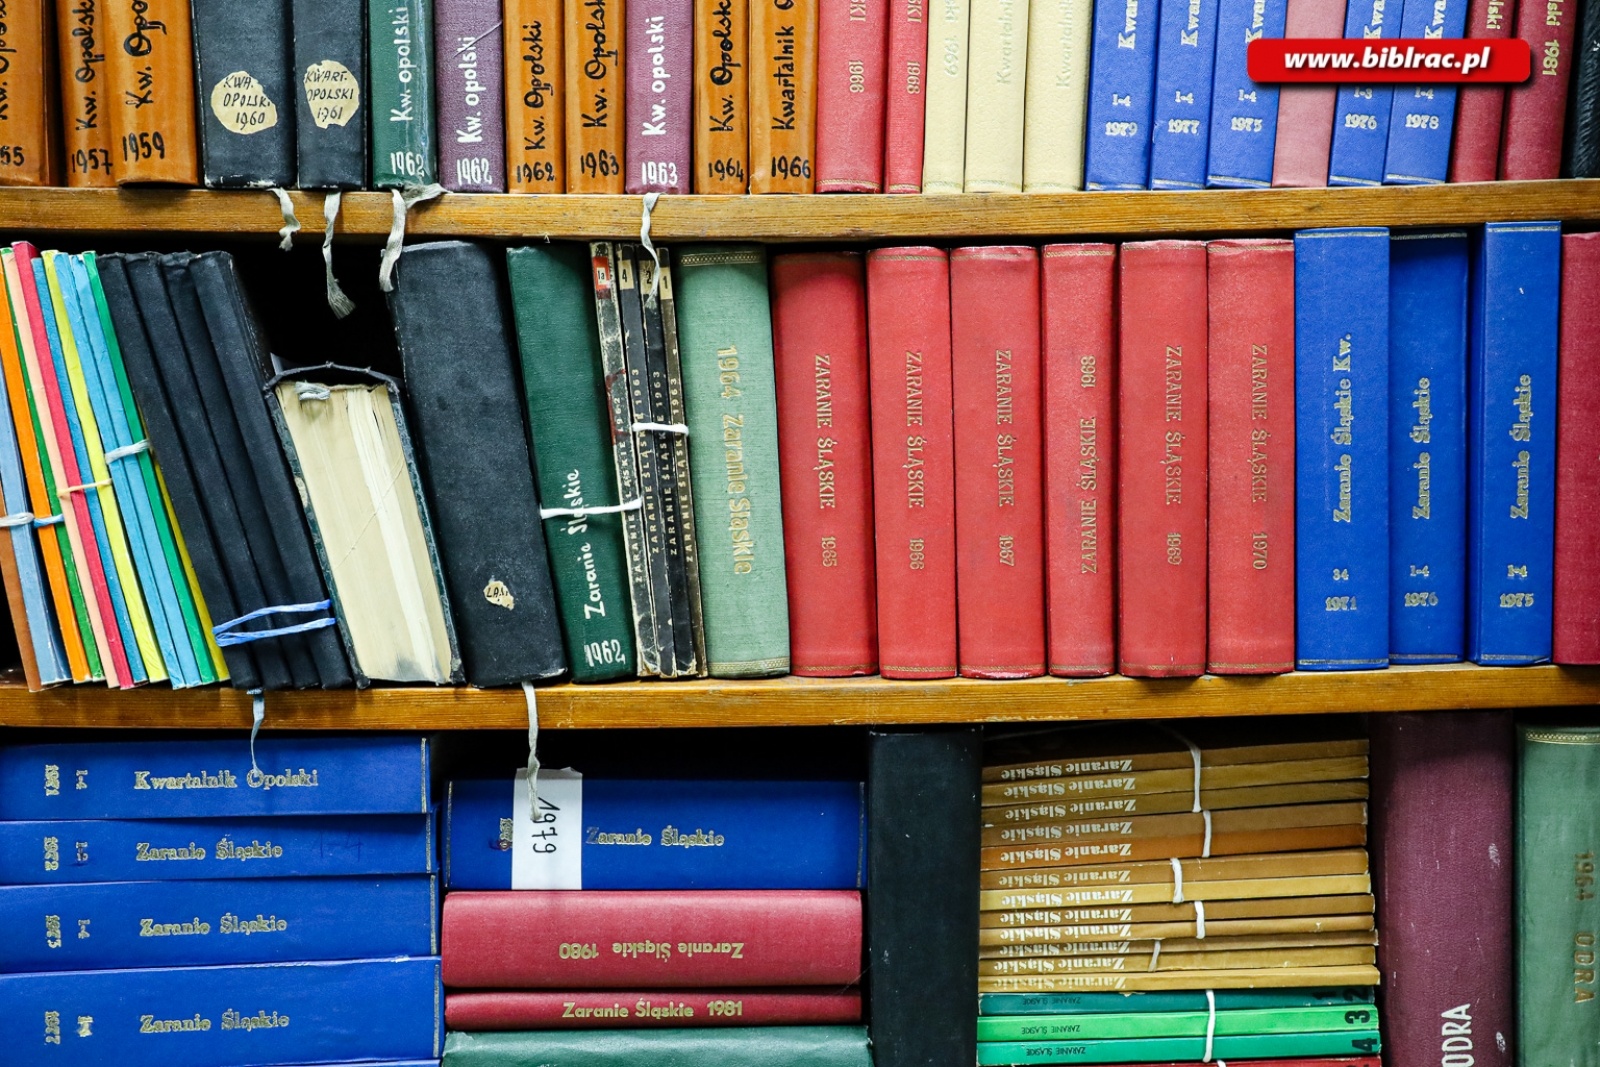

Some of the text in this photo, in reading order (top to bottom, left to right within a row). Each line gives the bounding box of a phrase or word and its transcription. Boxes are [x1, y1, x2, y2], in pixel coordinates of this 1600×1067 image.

[1542, 39, 1560, 76] 1981
[126, 67, 154, 108] Kw.
[456, 35, 486, 144] Kw. opolski
[642, 15, 672, 136] Kw. opolski
[771, 25, 796, 131] Kwartalnik
[848, 60, 865, 94] 1966
[906, 60, 921, 95] 1968
[75, 91, 97, 131] Kw.
[390, 88, 414, 122] Kw.
[582, 88, 608, 128] Kw.
[709, 94, 734, 132] Kw.
[236, 112, 265, 130] 1960
[524, 115, 546, 150] Kw.
[122, 131, 165, 162] 1959
[71, 148, 113, 175] 1957
[390, 151, 426, 178] 1962
[456, 158, 492, 185] 1962
[516, 161, 555, 183] 1962
[580, 149, 619, 178] 1963
[642, 162, 678, 186] 1963
[708, 158, 744, 182] 1964
[771, 156, 811, 180] 1966
[622, 268, 628, 282] 4
[663, 276, 668, 290] 1
[1333, 334, 1352, 372] Kw.
[716, 344, 742, 399] 1964
[631, 369, 660, 554] ZARANIE ŚLĄSKE 1963
[652, 371, 678, 556] ZARANIE ŚLĄSKE 1963
[722, 412, 748, 494] Zaranie
[813, 354, 838, 568] ZARANIE ŚLĄSKIE 1965
[902, 350, 927, 570] ZARANIE ŚLĄSKIE 1966
[992, 350, 1017, 567] ZARANIE ŚLĄSKIE 1967
[1076, 354, 1100, 574] ZARANIE ŚLĄSKIE 1968
[1160, 346, 1186, 566] ZARANIE ŚLĄSKIE 1969
[1247, 344, 1272, 570] ZARANIE ŚLĄSKIE 1970
[670, 378, 694, 563] ZARANIE 1963
[1510, 450, 1530, 520] Zaranie
[1333, 454, 1352, 522] Zaranie
[1412, 452, 1431, 520] Zaranie
[628, 514, 644, 583] ZARANIE
[578, 542, 606, 620] Zaranie
[584, 639, 626, 668] 1962
[134, 769, 319, 790] Kwartalnik Opolski
[1066, 760, 1132, 775] Zaranie
[1068, 778, 1136, 793] Zaranie
[1070, 799, 1136, 814] Zaranie
[532, 796, 561, 854] 1979
[586, 826, 652, 846] Zaranie
[1066, 822, 1132, 836] Zaranie
[136, 842, 206, 862] Zaranie
[1065, 844, 1132, 859] Zaranie
[1064, 870, 1130, 886] Zaranie
[1066, 890, 1134, 905] Zaranie
[140, 917, 211, 937] Zaranie
[1064, 908, 1132, 922] Zaranie
[1064, 924, 1132, 938] Zaranie
[558, 943, 600, 960] 1980
[678, 942, 745, 959] Zaranie
[1064, 942, 1130, 954] Zaranie
[1058, 958, 1126, 970] Zaranie
[1574, 931, 1596, 1004] ODRA
[1059, 976, 1126, 989] Zaranie
[140, 1013, 212, 1034] Zaranie
[562, 998, 744, 1020] Zaranie Śląskie 1981
[1344, 1010, 1370, 1024] 3
[1051, 1025, 1080, 1034] ZARANIE
[1441, 1003, 1475, 1067] ODRA
[1056, 1046, 1086, 1055] ZARANIE
[1352, 1038, 1378, 1052] 4
